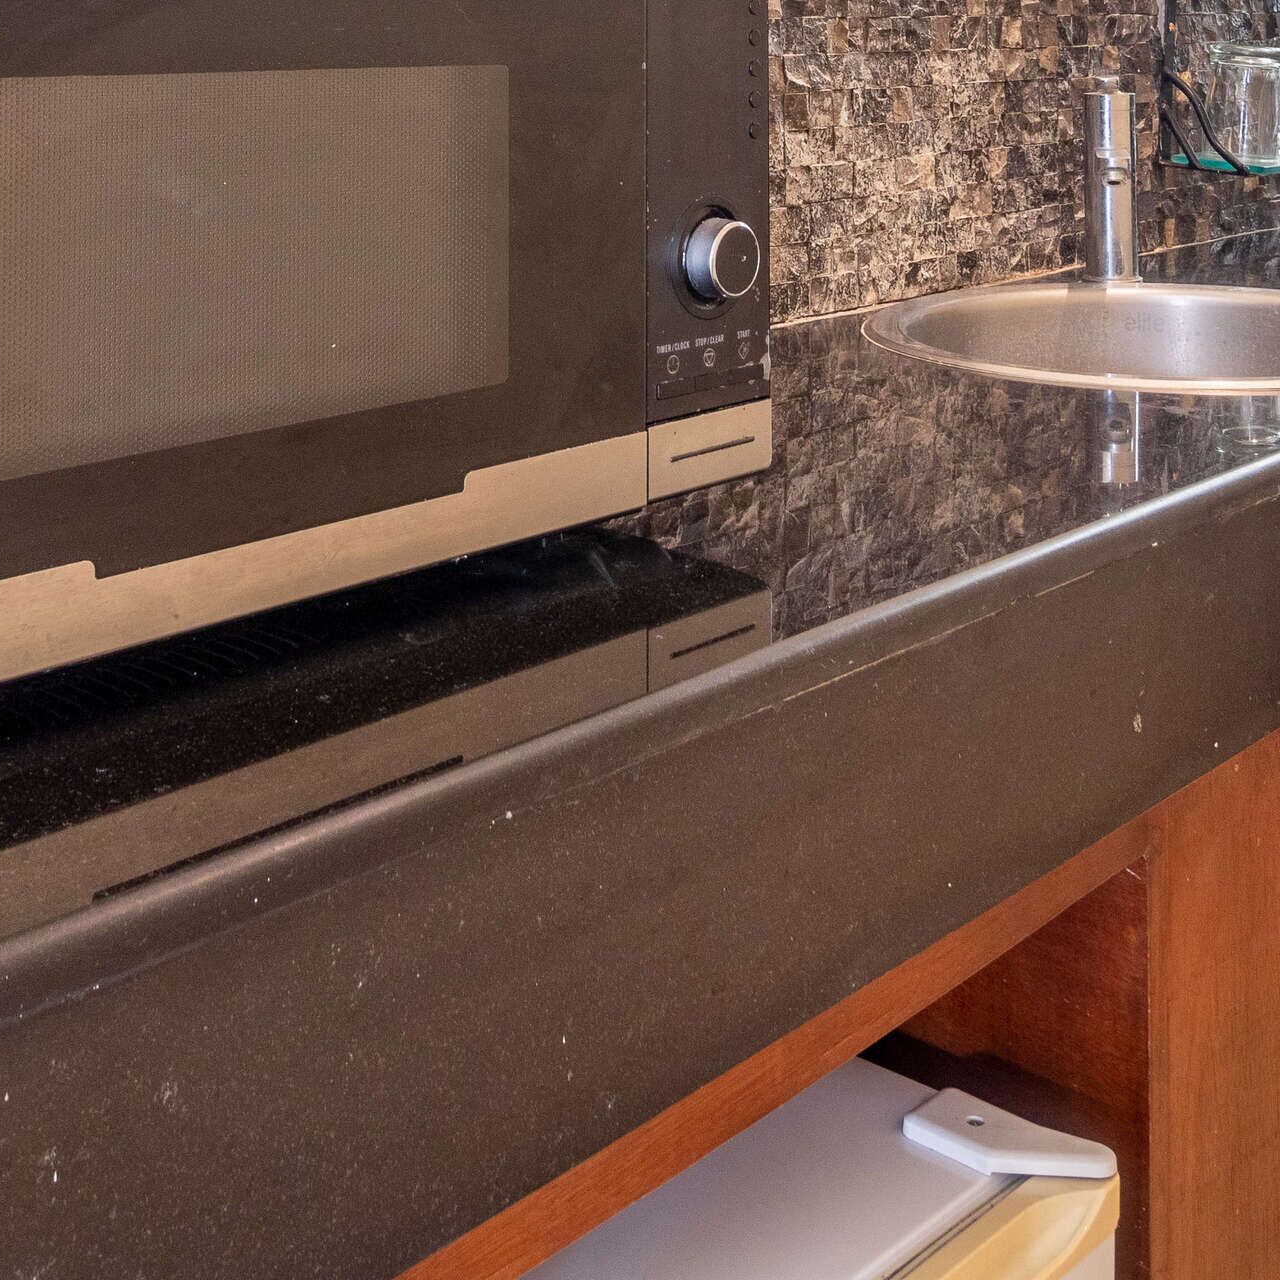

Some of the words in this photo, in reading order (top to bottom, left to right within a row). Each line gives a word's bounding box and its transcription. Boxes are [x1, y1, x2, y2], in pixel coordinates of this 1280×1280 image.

[695, 334, 725, 348] STOP/CLEAR
[737, 329, 750, 340] START
[656, 341, 690, 354] TIMER/CLOCK
